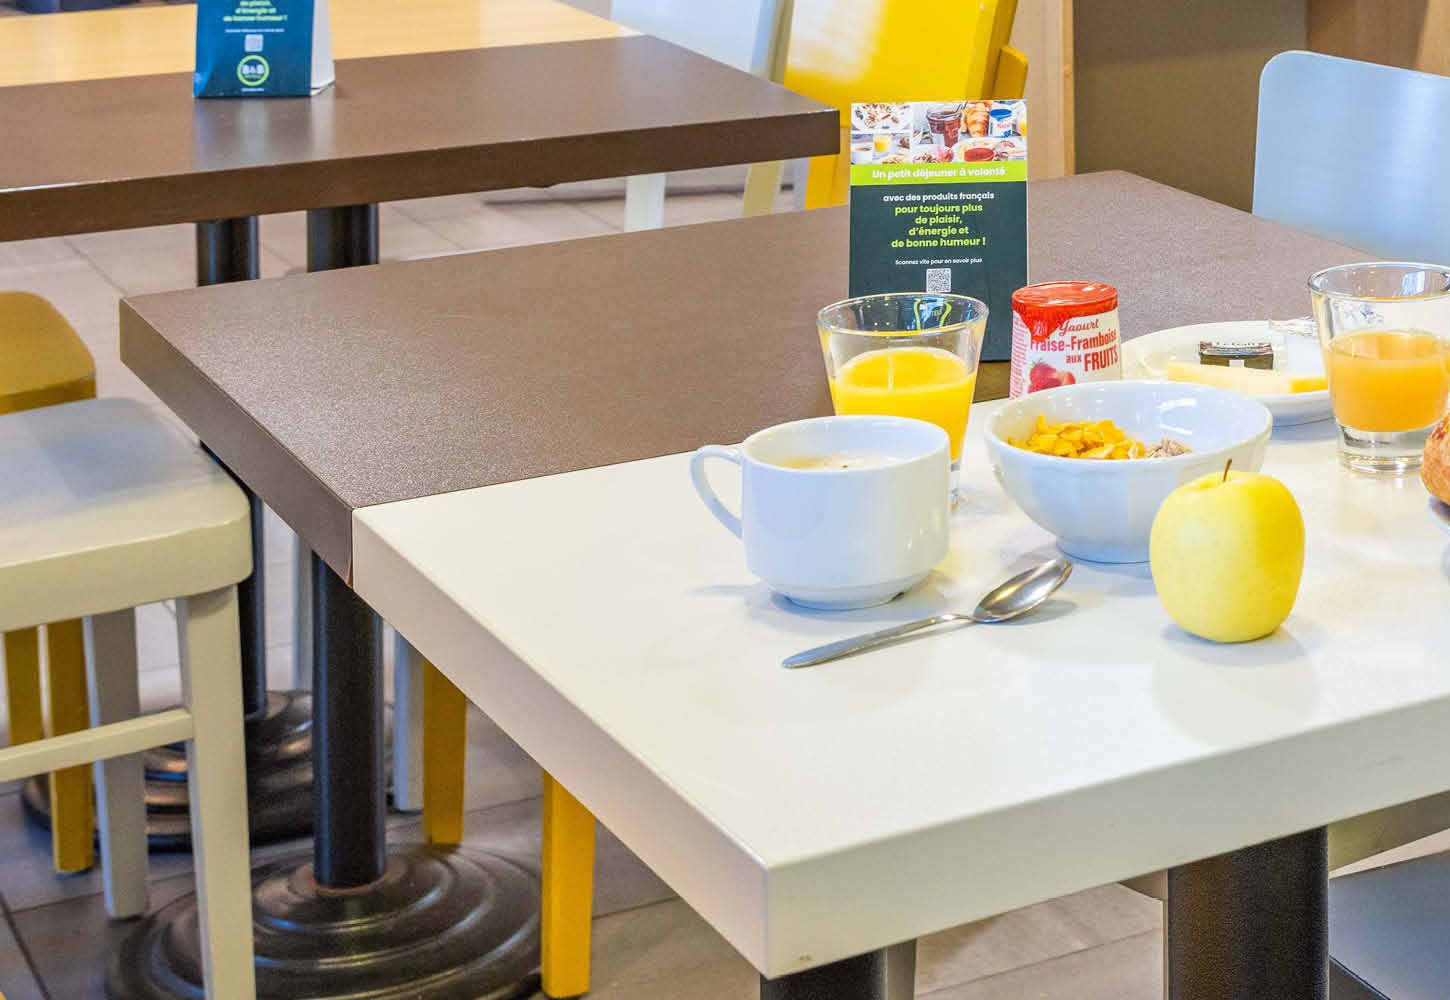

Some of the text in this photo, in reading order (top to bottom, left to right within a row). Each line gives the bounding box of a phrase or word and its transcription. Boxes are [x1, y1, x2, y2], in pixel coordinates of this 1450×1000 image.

[242, 64, 265, 74] B&B
[872, 166, 1006, 180] Un petit déjeuner à volonté
[883, 191, 995, 203] avec des produits français
[895, 204, 983, 216] pour toujours plus
[915, 215, 962, 226] de plaisir,
[958, 226, 969, 234] et
[891, 240, 904, 248] de
[906, 238, 939, 247] bonne
[940, 237, 981, 247] humeur
[970, 257, 983, 265] plus
[1059, 318, 1100, 337] Yaourt
[1065, 345, 1119, 372] aux FRUITS
